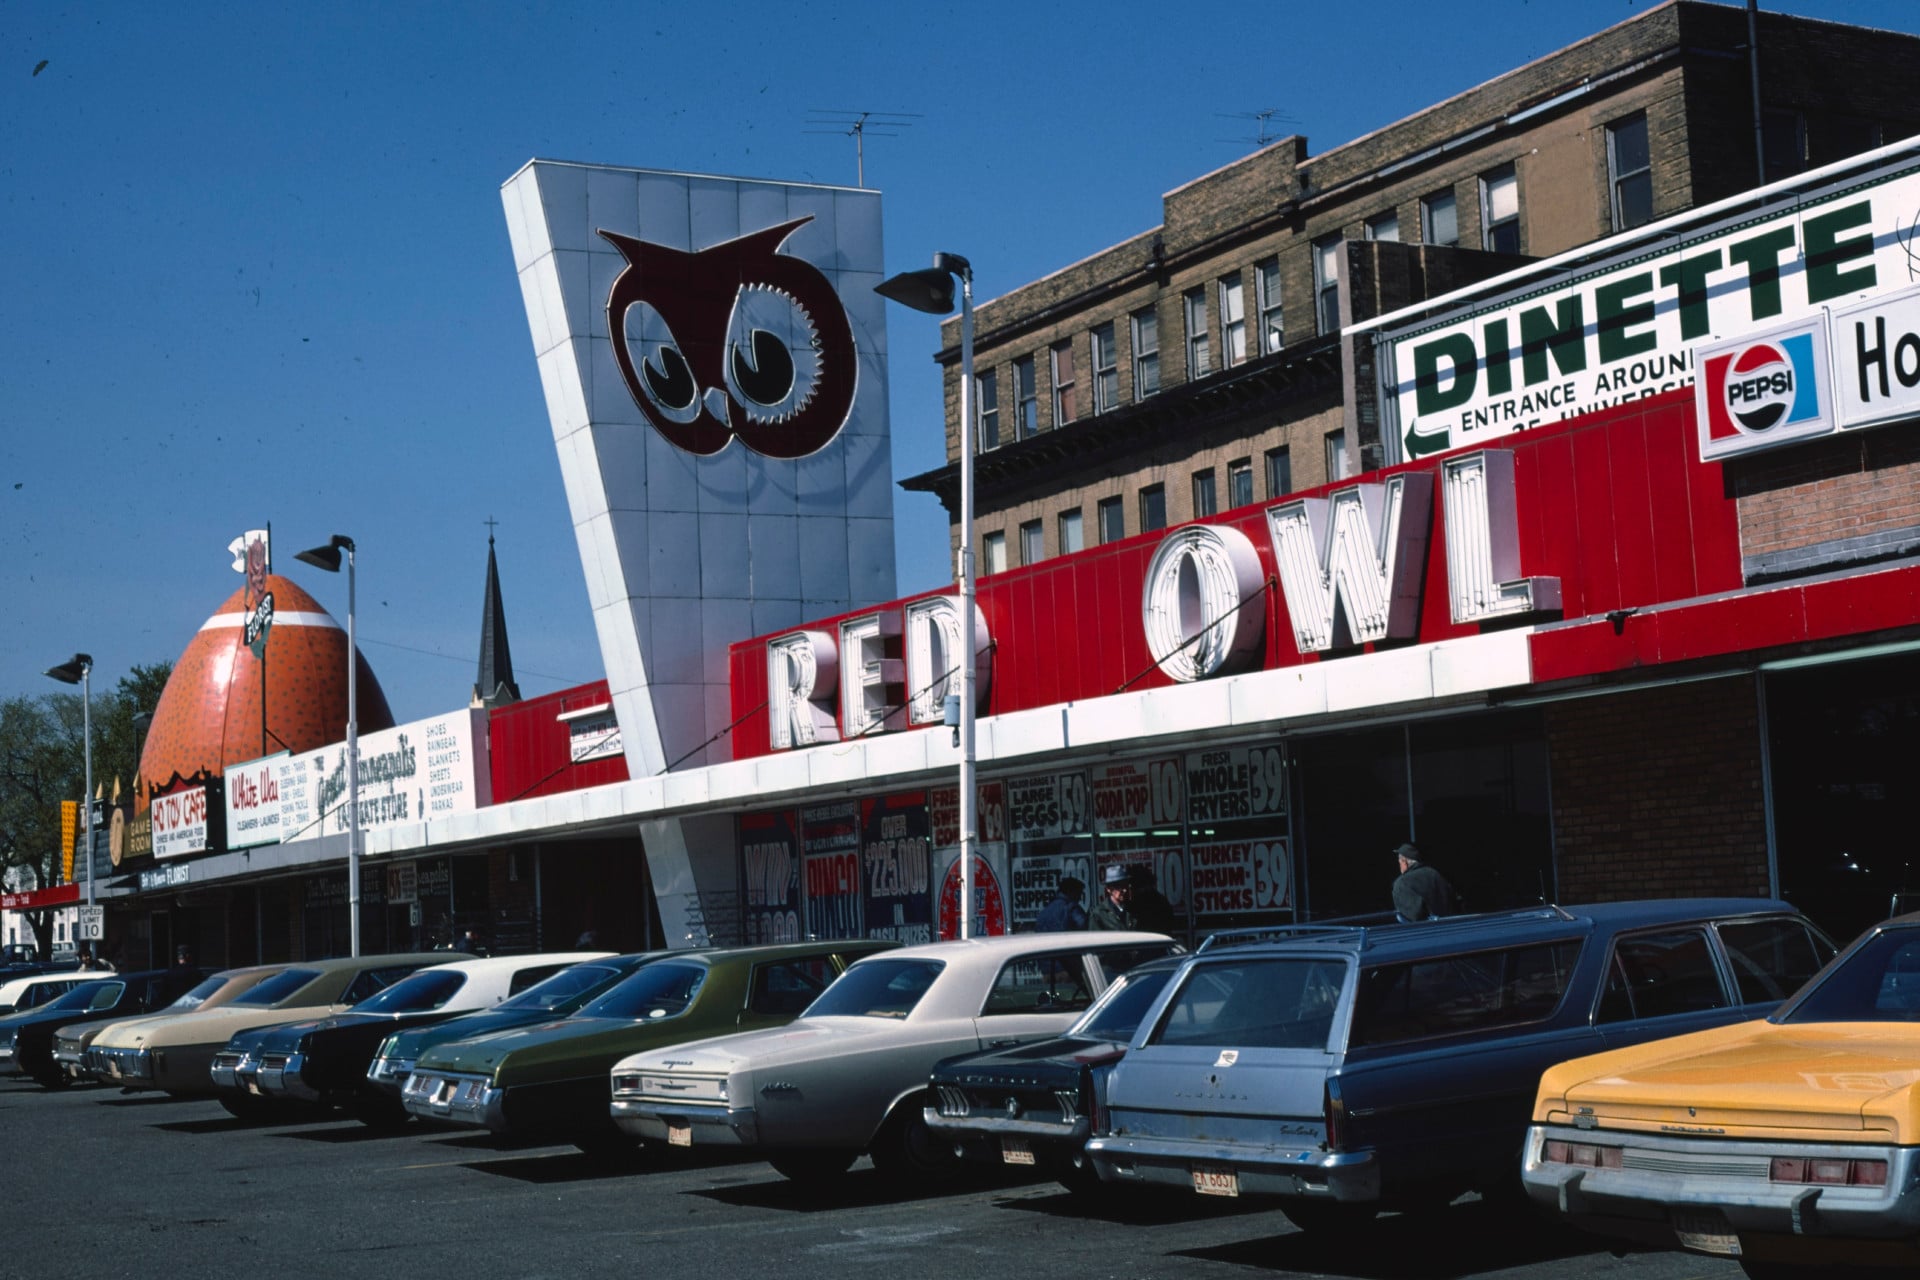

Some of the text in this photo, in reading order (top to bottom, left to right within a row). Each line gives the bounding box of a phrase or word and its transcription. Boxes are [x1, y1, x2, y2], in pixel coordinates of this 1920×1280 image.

[1413, 199, 1877, 418] DINETTE
[1461, 347, 1695, 433] ENTRANCE AROUN
[1727, 368, 1794, 407] PEPSI
[767, 447, 1563, 751] RED OWL
[247, 594, 273, 643] FLORIST
[426, 723, 447, 738] SHOES
[427, 735, 456, 752] RAINGEAR
[428, 749, 461, 768] BLANKETS
[1202, 751, 1231, 768] FRESH
[430, 767, 451, 783] SHEETS
[1189, 747, 1283, 813] WHOLE 39
[231, 772, 259, 811] White
[430, 780, 464, 798] UNDERWEAR
[931, 786, 960, 809] FRE
[1095, 761, 1180, 824] SODA POP 10
[153, 790, 207, 832] HO TOY CAFE
[1010, 801, 1059, 829] EGGS
[1013, 774, 1087, 833] LARGE 59
[1189, 792, 1250, 822] FRYERS
[880, 814, 907, 840] OVER
[931, 807, 960, 833] SWE
[1192, 842, 1251, 867] TURKEY
[166, 864, 189, 885] FLORIST
[744, 840, 791, 907] WIN
[1014, 868, 1062, 889] BUFFET
[1255, 841, 1290, 908] 39
[81, 908, 103, 917] SPEED
[1195, 887, 1253, 913] STICKS
[83, 917, 101, 925] LIMIT
[85, 924, 99, 937] 10
[869, 922, 931, 945] CASH PRIZES
